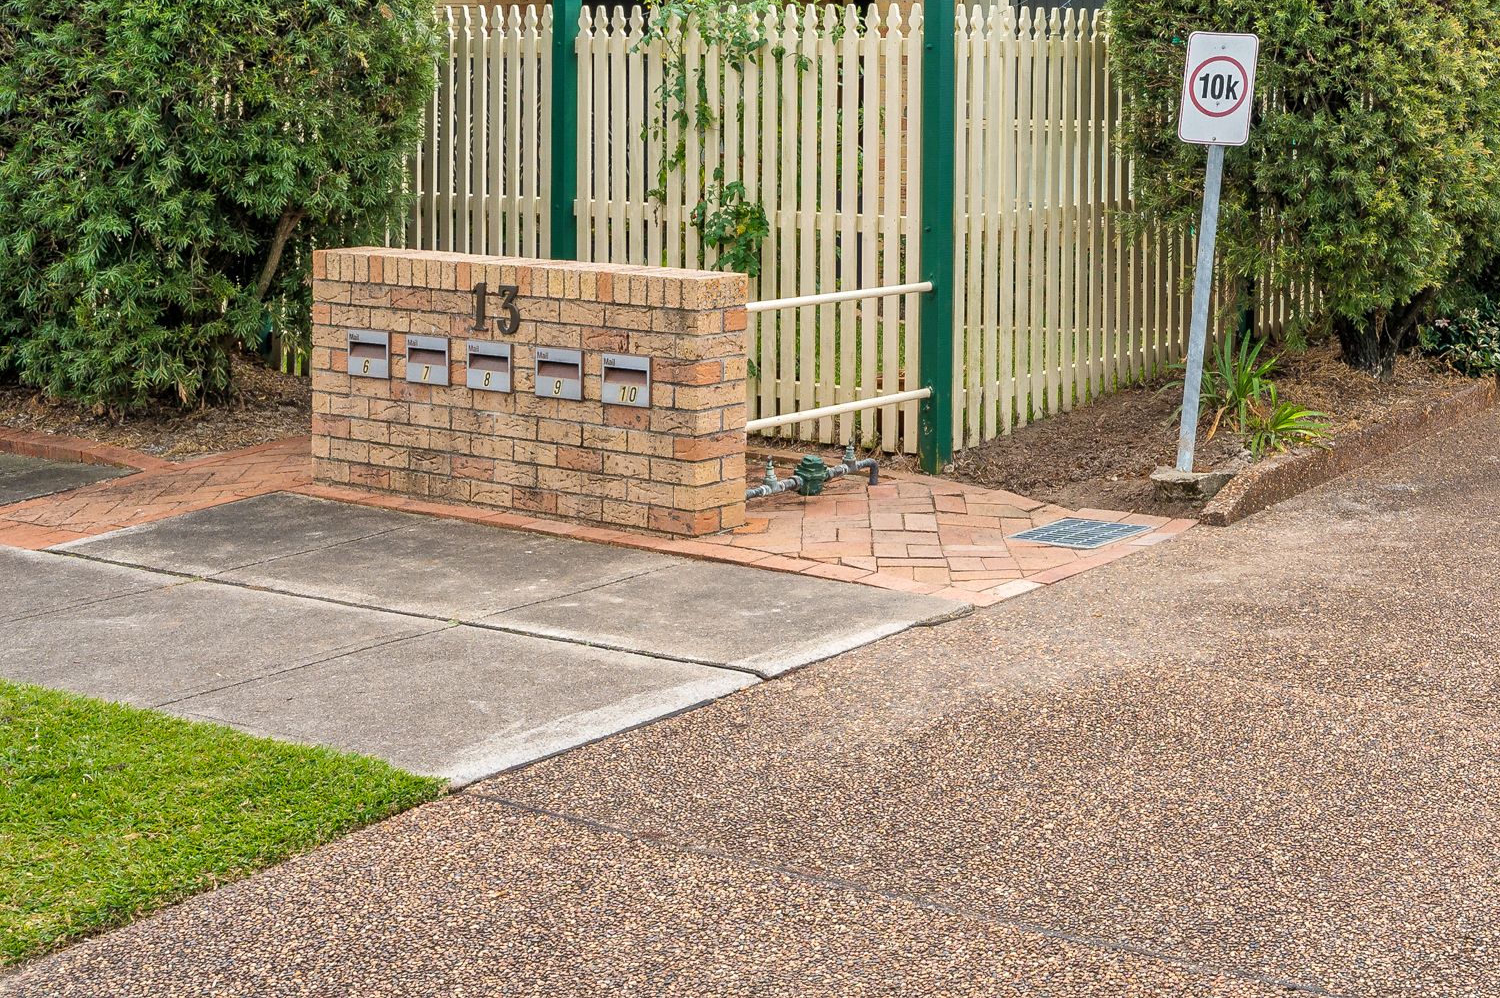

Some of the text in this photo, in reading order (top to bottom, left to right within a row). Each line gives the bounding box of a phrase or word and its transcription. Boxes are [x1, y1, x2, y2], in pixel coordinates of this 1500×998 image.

[1199, 73, 1239, 100] 10k
[471, 282, 520, 334] 13
[349, 333, 360, 341] Mail
[537, 351, 549, 359] Mail
[604, 357, 616, 366] Mail
[363, 359, 370, 374] 6
[423, 366, 430, 379] 7
[484, 372, 491, 386] 8
[554, 380, 561, 394] 9
[621, 386, 637, 402] 10
